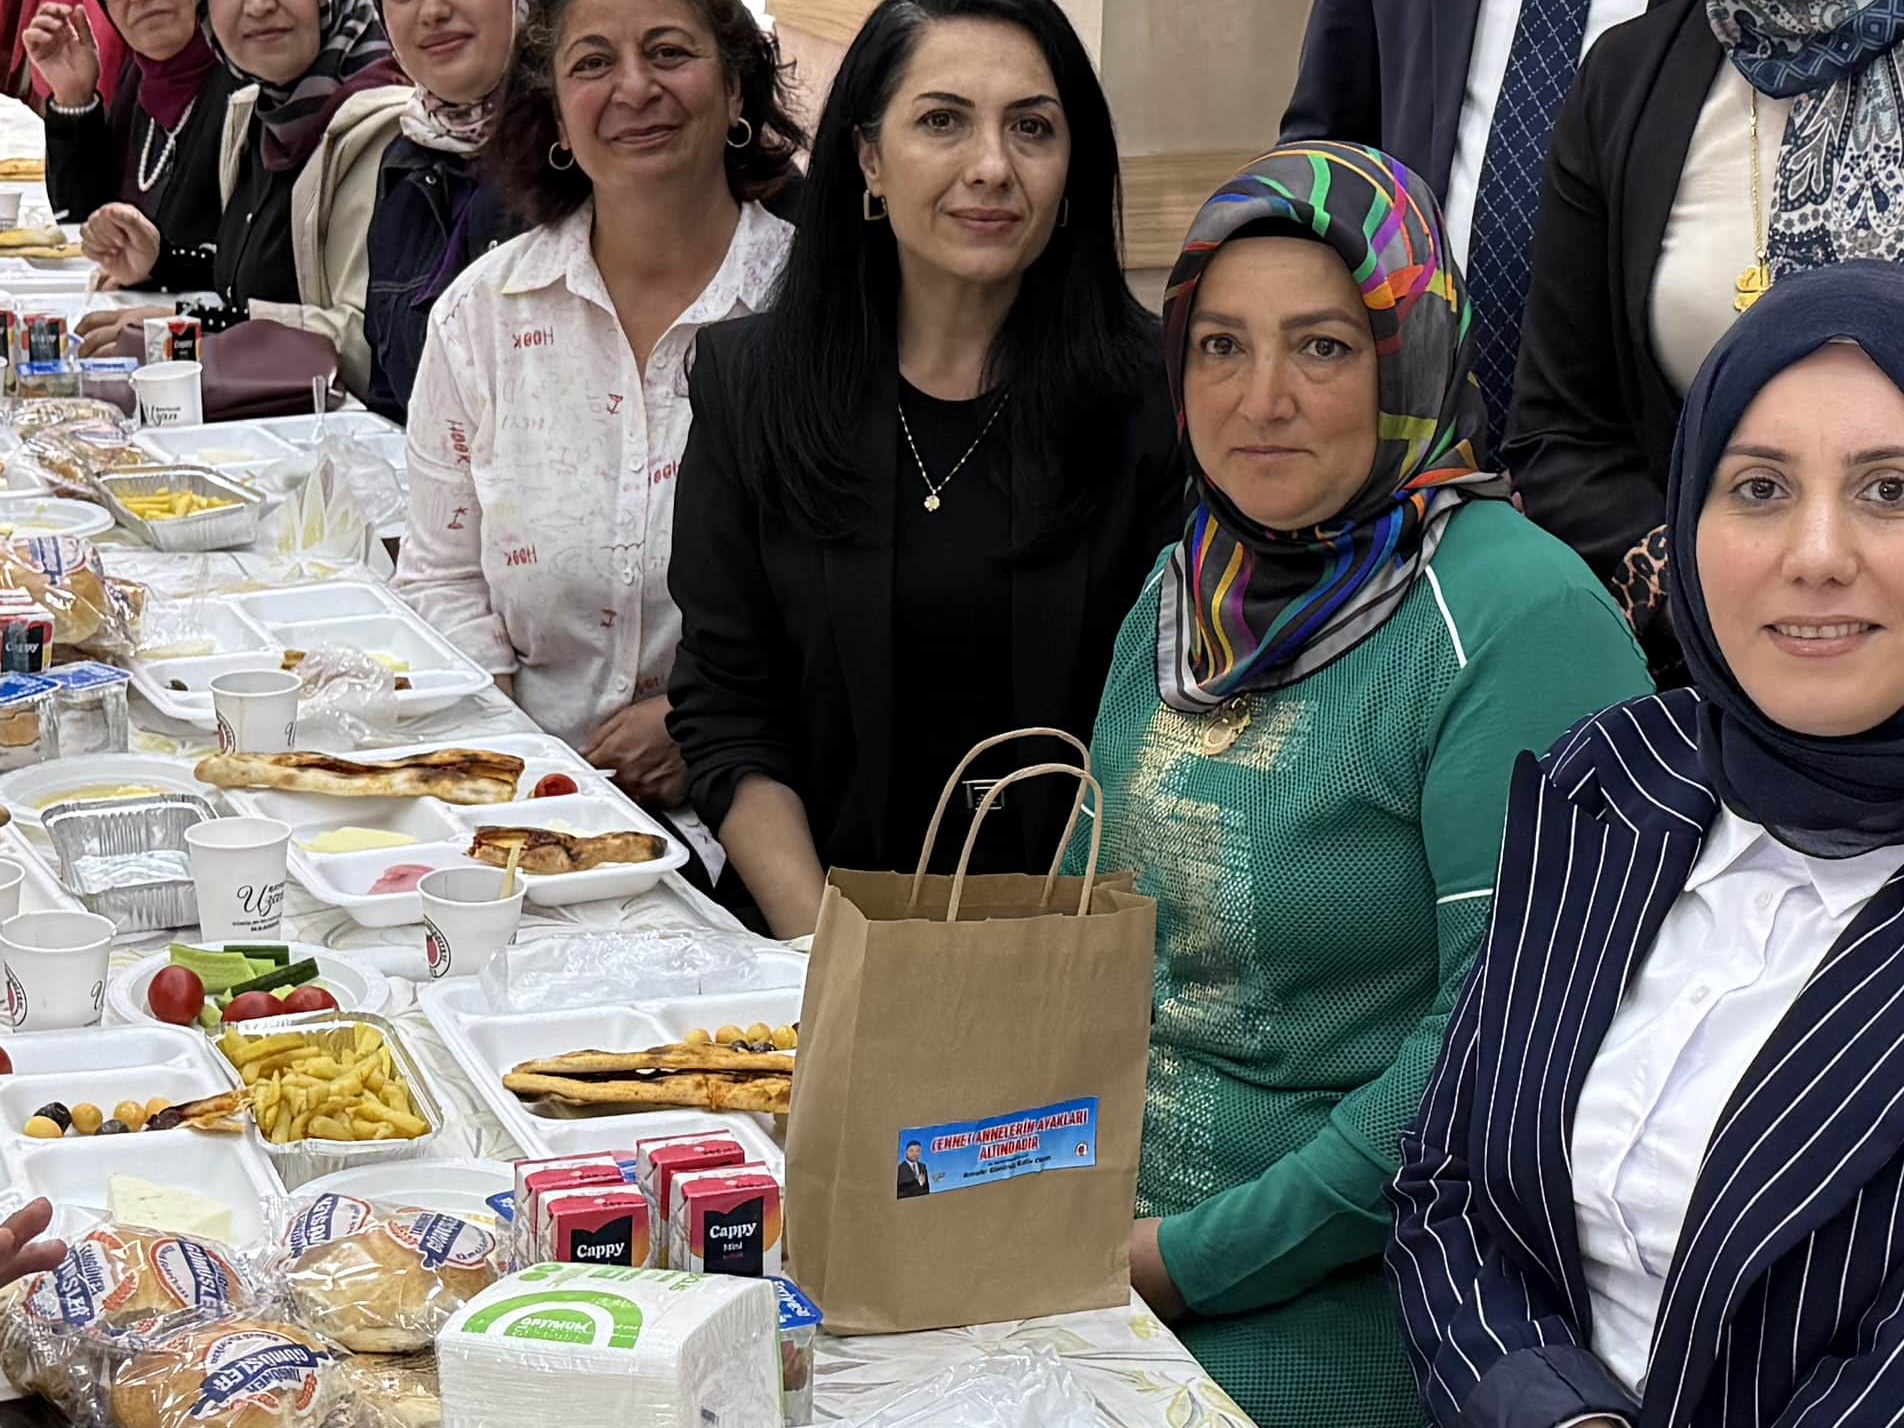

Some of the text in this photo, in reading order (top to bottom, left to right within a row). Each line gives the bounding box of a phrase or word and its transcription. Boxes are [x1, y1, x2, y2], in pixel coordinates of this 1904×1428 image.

[1036, 1108, 1089, 1132] AYAKLARI
[979, 1135, 1039, 1162] ALTINDADIR
[709, 1222, 757, 1240] Cappy
[576, 1241, 625, 1260] Cappy
